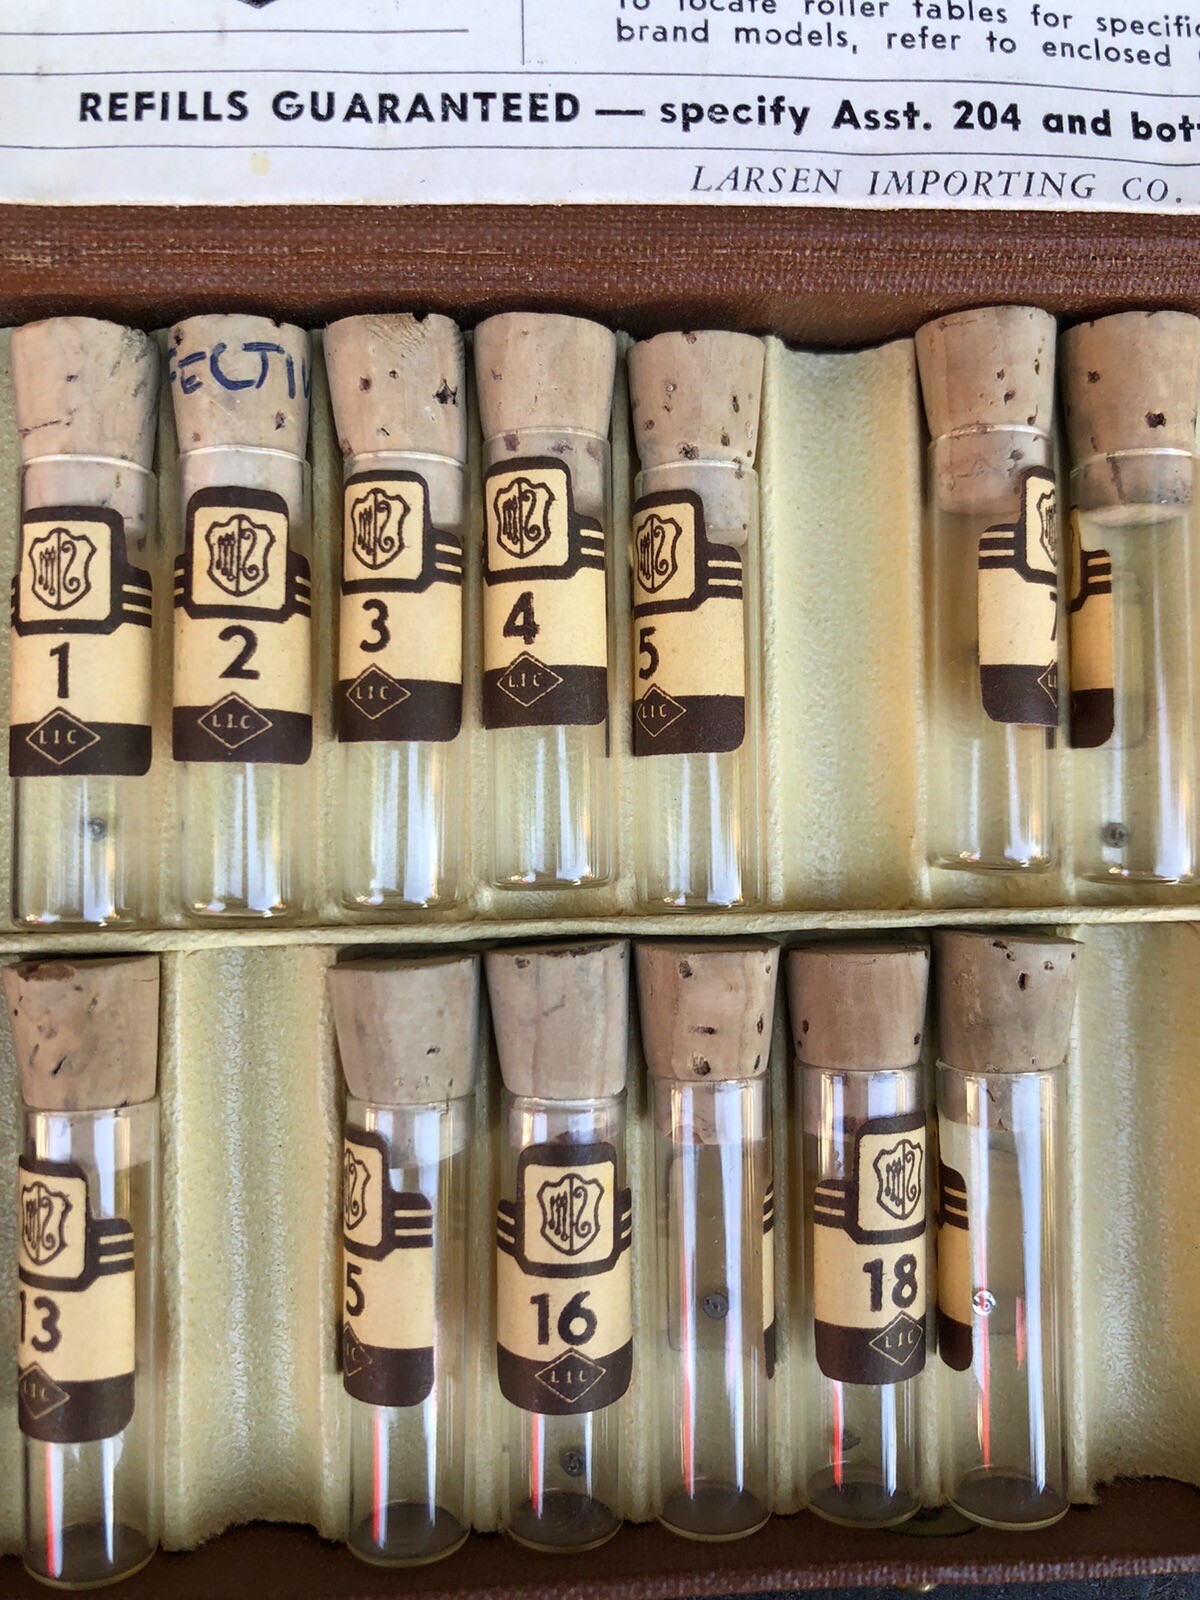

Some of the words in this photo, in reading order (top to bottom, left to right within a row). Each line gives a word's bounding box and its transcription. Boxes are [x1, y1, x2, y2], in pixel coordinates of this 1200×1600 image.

[802, 0, 894, 20] roller
[913, 0, 1007, 23] tables
[1031, 4, 1072, 28] for
[617, 18, 708, 42] brand
[735, 22, 857, 54] models,
[887, 26, 960, 50] refer
[986, 31, 1016, 53] to
[1042, 34, 1170, 66] enclosed
[80, 91, 248, 121] REFILLS
[272, 91, 579, 123] GUARANTEED
[661, 95, 810, 135] specify
[832, 100, 931, 130] Asst.
[953, 100, 1021, 131] 204
[1043, 109, 1111, 137] and
[1131, 111, 1200, 142] bot
[691, 166, 842, 194] LARSEN
[868, 170, 1095, 198] IMPORTING
[1122, 177, 1182, 203] CO.
[360, 598, 391, 653] 3
[502, 591, 541, 646] 4
[50, 642, 71, 699] 1
[218, 625, 261, 680] 2
[638, 626, 660, 681] 5
[862, 1254, 918, 1313] 18
[20, 1290, 62, 1353] 13
[530, 1290, 598, 1347] 16
